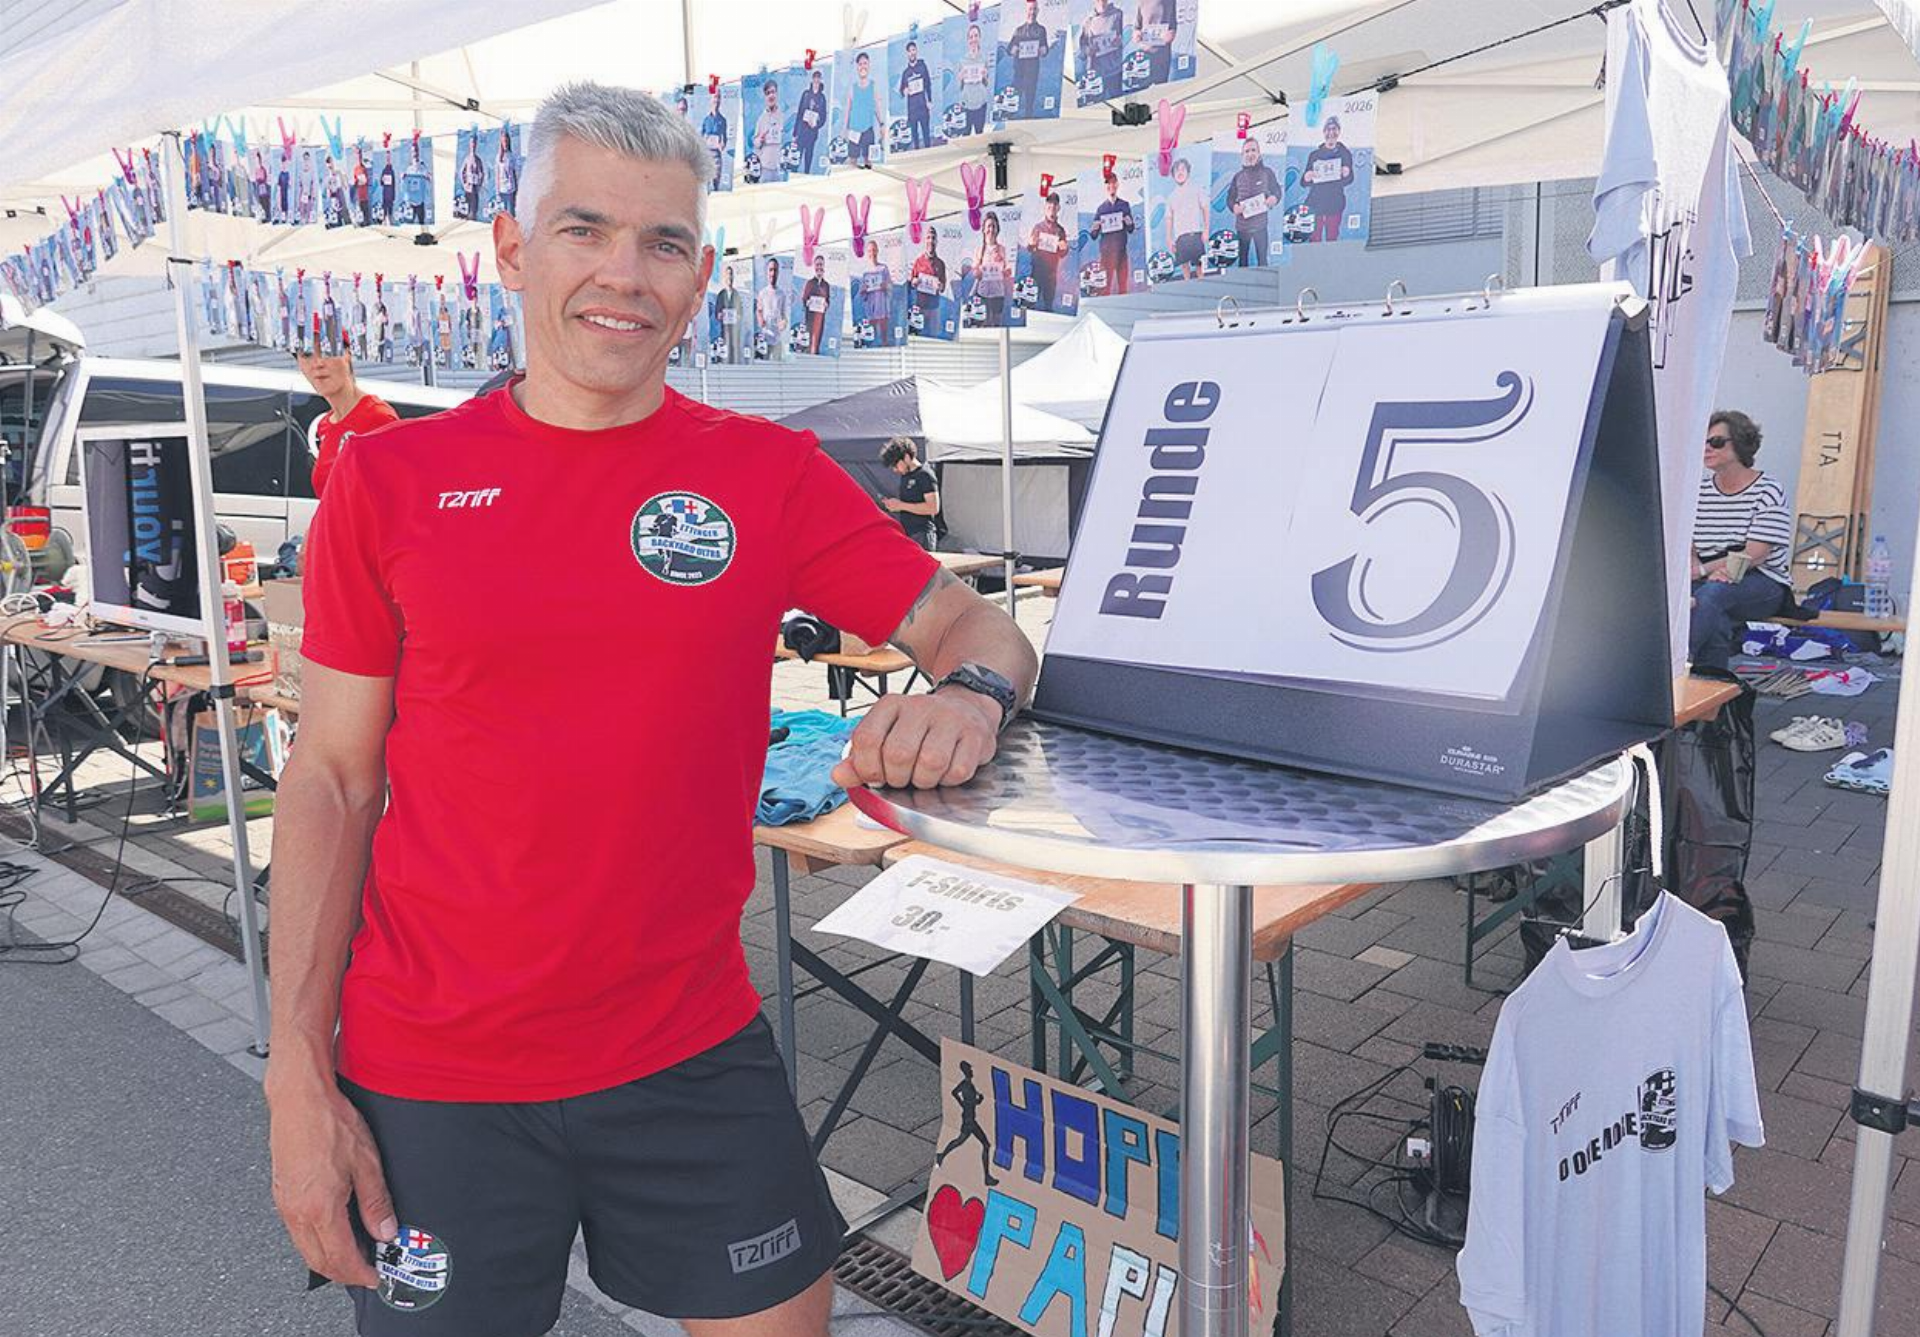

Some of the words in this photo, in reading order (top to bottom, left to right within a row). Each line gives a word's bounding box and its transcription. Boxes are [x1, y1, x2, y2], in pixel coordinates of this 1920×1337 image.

[1344, 100, 1373, 114] 2026
[1266, 131, 1288, 145] 202
[1818, 431, 1842, 468] TTA
[1099, 380, 1222, 620] Runde
[1311, 370, 1535, 653] 5
[905, 870, 1025, 912] T-Shirts
[967, 1189, 1180, 1337] PAPI
